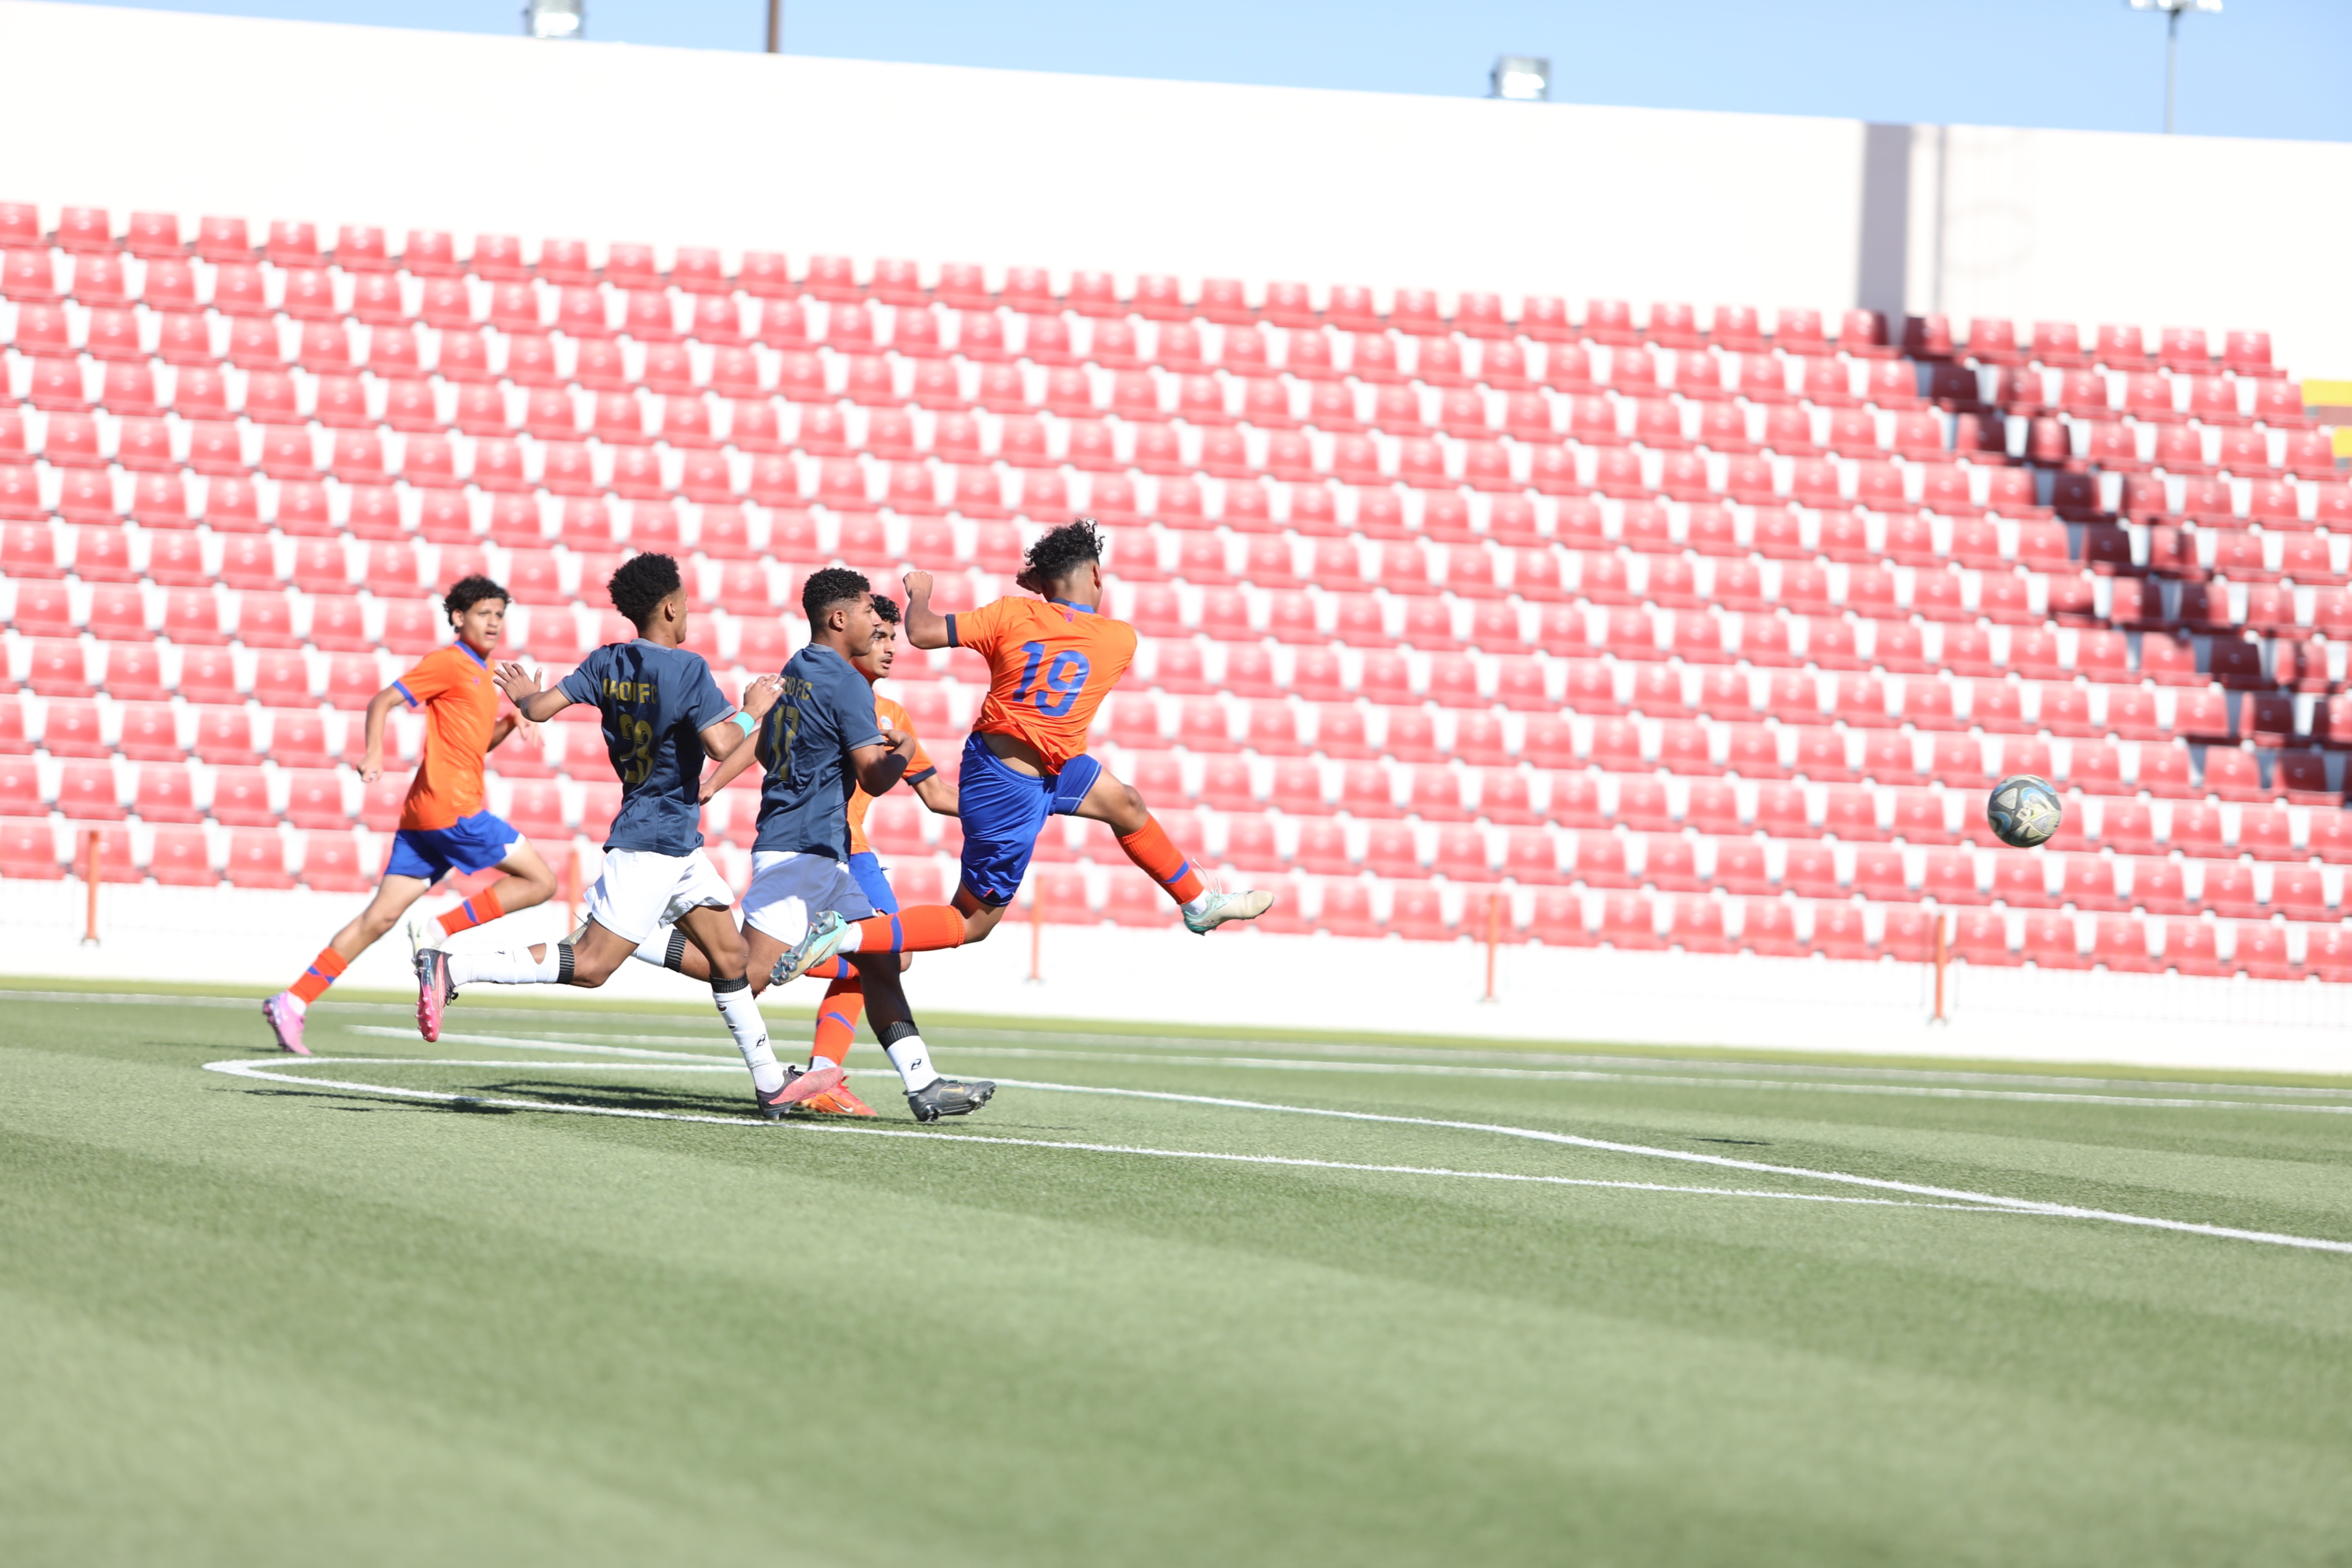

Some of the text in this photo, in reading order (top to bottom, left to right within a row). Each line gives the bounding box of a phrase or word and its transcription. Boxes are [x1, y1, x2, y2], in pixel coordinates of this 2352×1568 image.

[1012, 641, 1090, 717] 19
[619, 714, 654, 784] 23
[768, 704, 800, 780] 17
